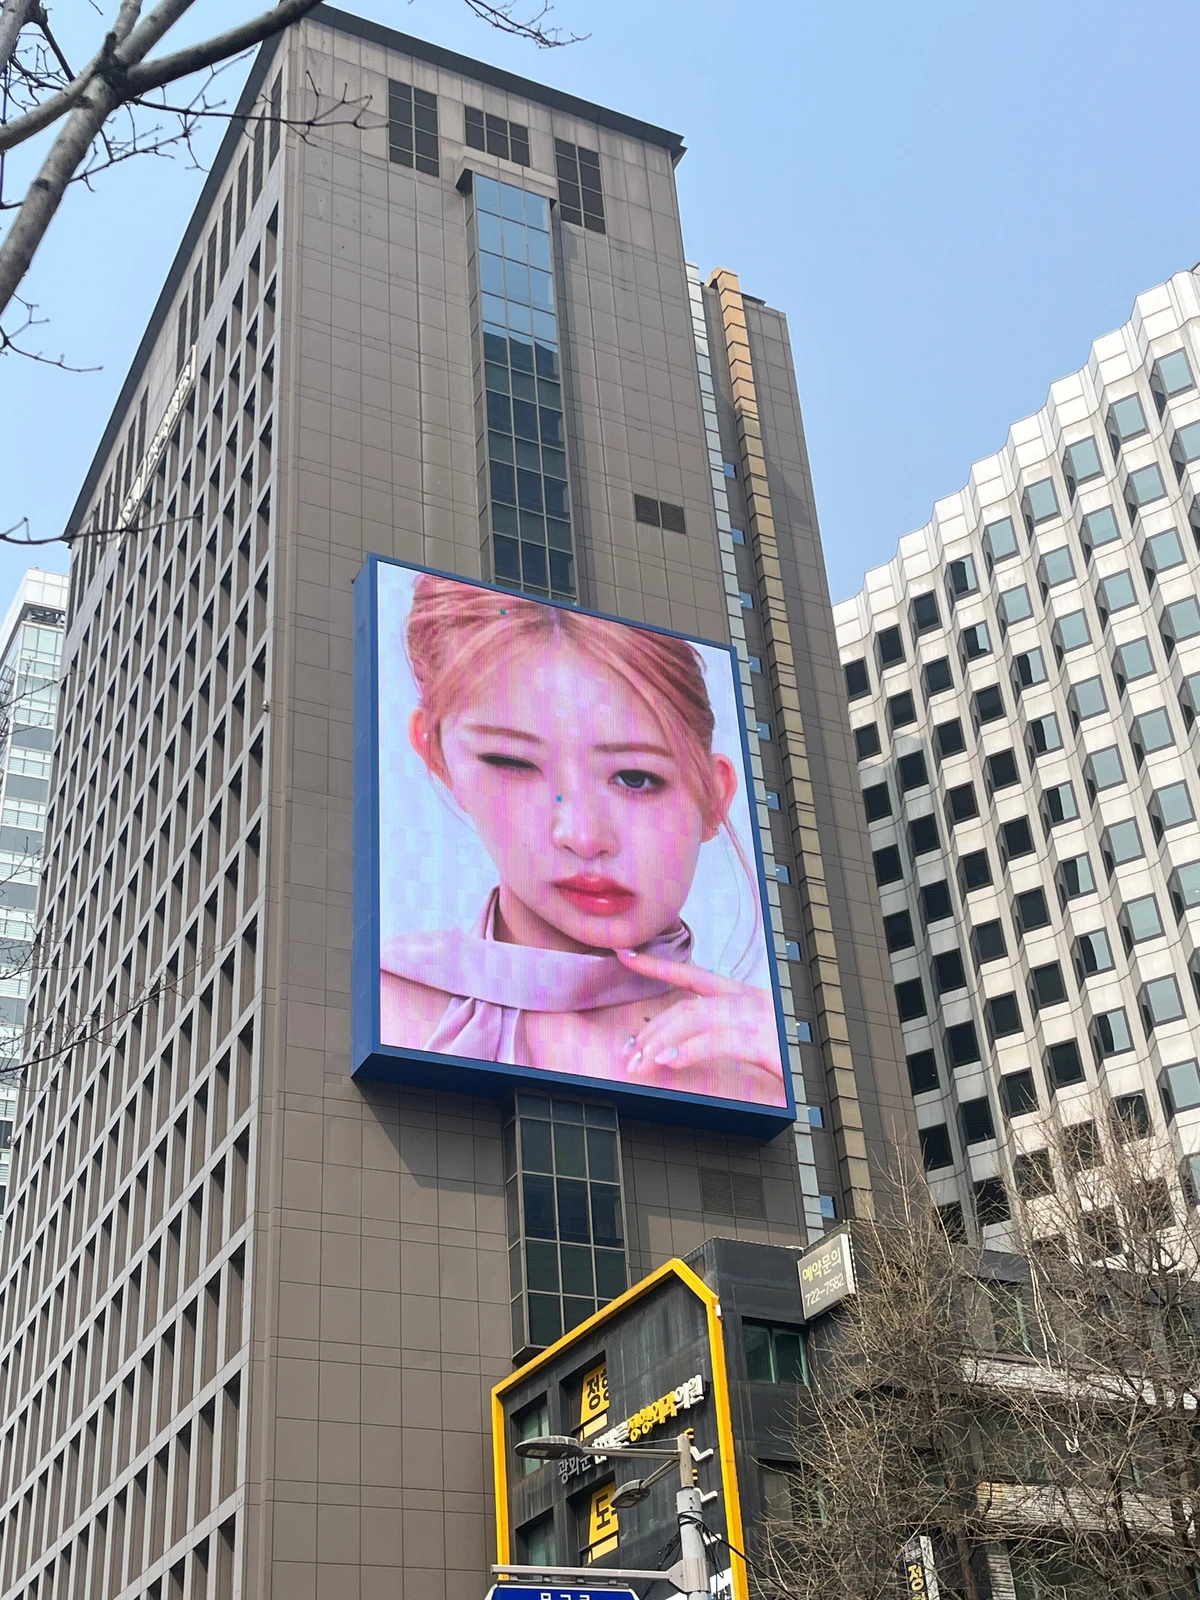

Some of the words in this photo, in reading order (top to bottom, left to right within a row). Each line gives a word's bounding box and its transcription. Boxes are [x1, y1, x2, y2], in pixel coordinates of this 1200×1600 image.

[802, 1247, 842, 1282] 예약문의
[805, 1273, 845, 1307] 722-7582
[595, 1493, 618, 1531] 도
